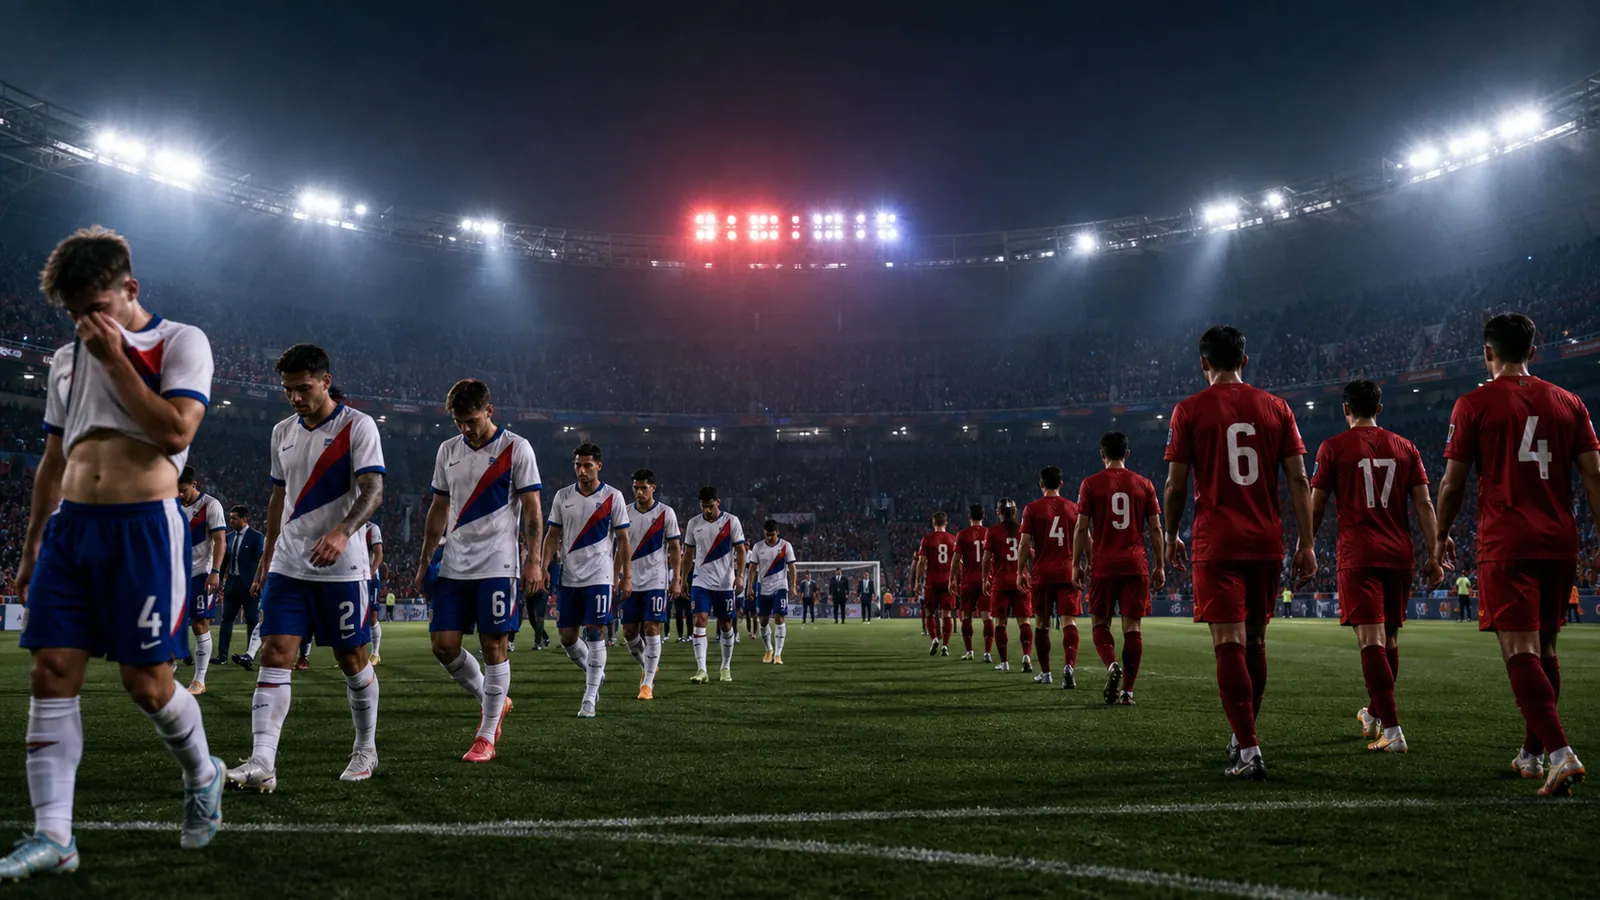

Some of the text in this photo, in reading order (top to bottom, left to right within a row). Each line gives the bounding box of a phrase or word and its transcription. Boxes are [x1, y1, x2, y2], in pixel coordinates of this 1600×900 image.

[1226, 422, 1259, 486] 6
[1517, 415, 1553, 480] 4
[1357, 458, 1397, 509] 17
[1111, 491, 1131, 531] 9
[1048, 515, 1065, 547] 4
[937, 543, 949, 565] 8
[973, 540, 986, 563] 1
[1006, 537, 1019, 562] 3
[136, 595, 163, 638] 4
[196, 594, 205, 610] 8
[338, 600, 355, 631] 2
[491, 590, 506, 618] 6
[595, 594, 608, 613] 11
[651, 596, 664, 612] 10
